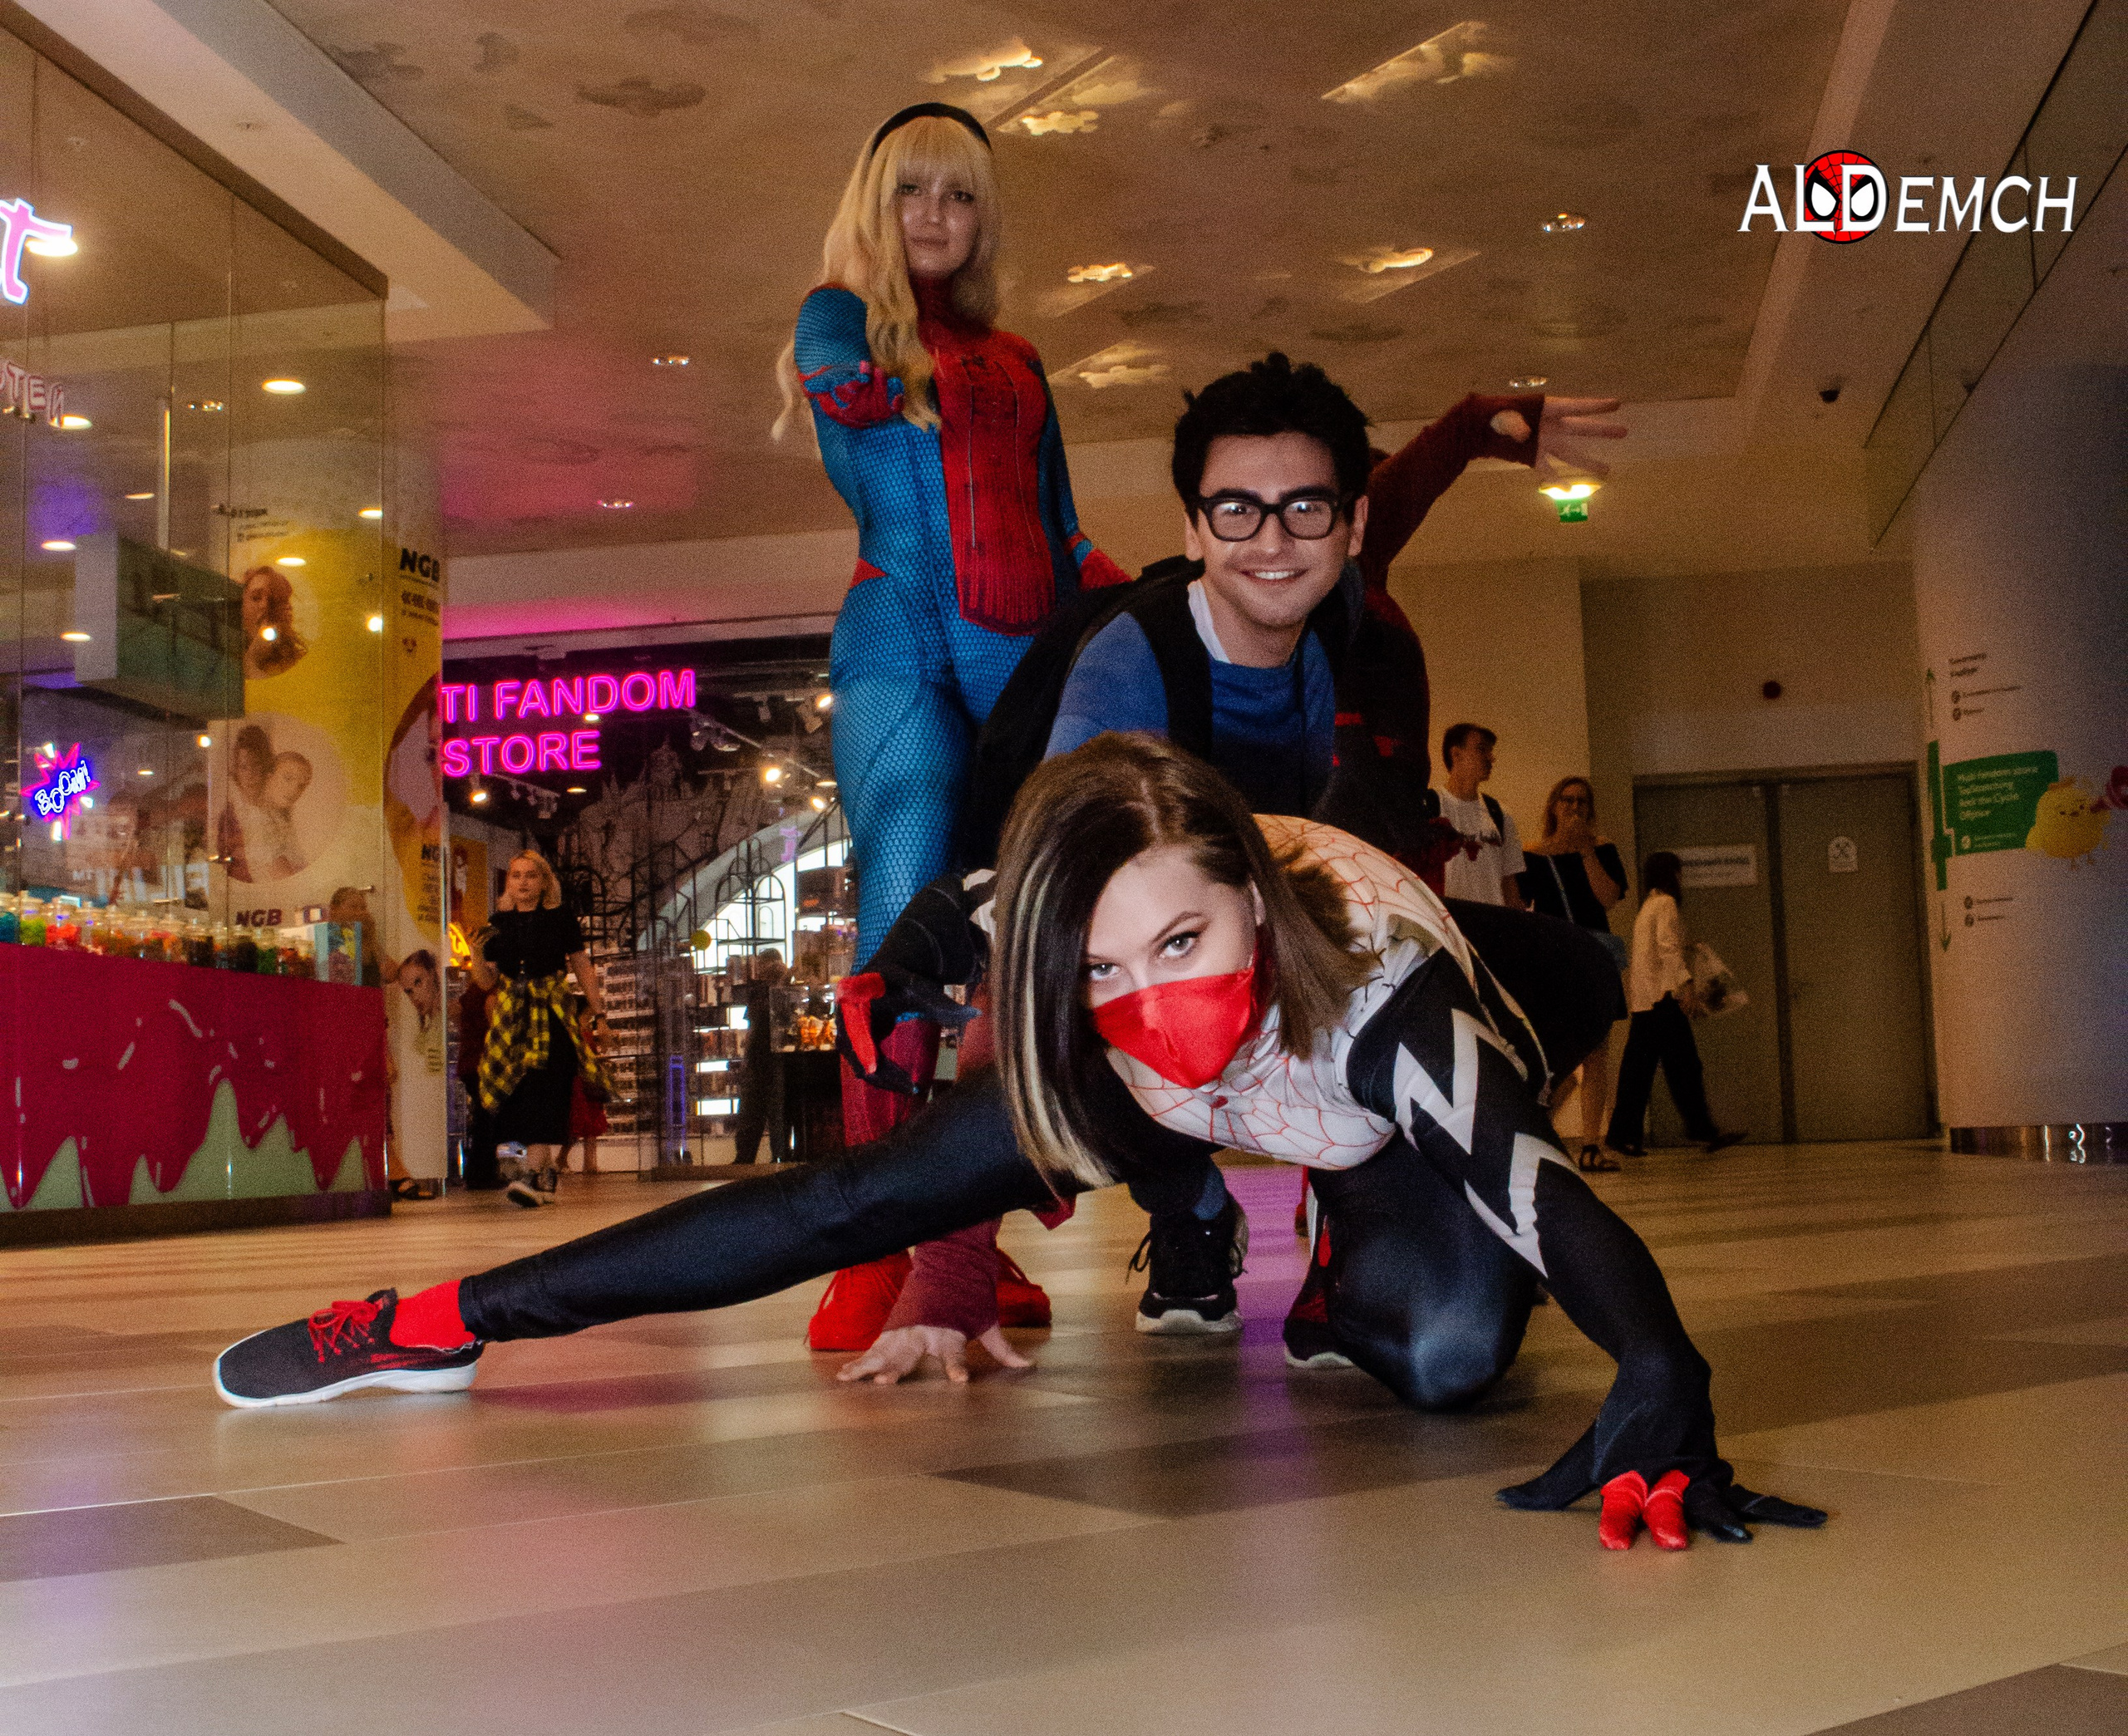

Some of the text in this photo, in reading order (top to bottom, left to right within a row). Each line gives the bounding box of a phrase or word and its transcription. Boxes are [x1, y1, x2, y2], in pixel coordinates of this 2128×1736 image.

[494, 668, 697, 720] FANDOM
[441, 730, 602, 778] STORE
[235, 908, 283, 927] NGB
